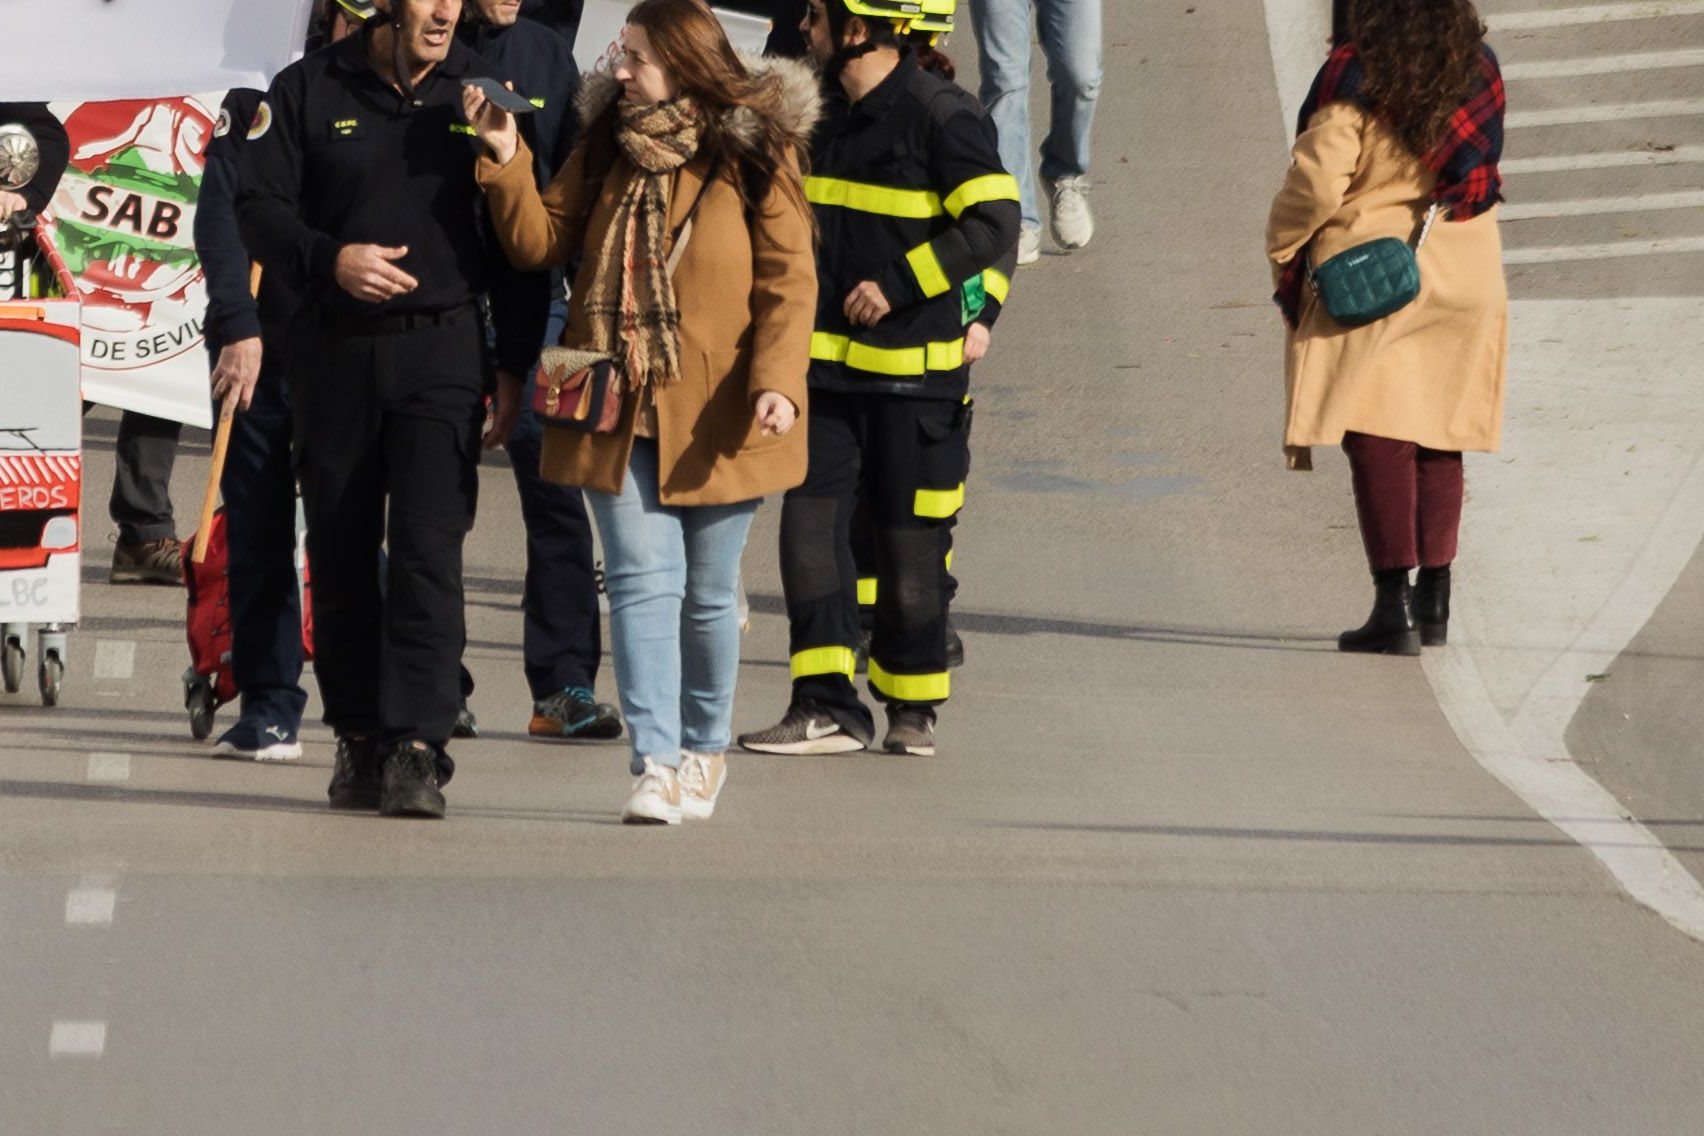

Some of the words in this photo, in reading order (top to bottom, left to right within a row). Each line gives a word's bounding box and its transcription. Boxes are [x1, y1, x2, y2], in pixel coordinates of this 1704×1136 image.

[80, 181, 183, 241] SAB
[90, 338, 126, 361] DE
[135, 317, 206, 359] SEVIL
